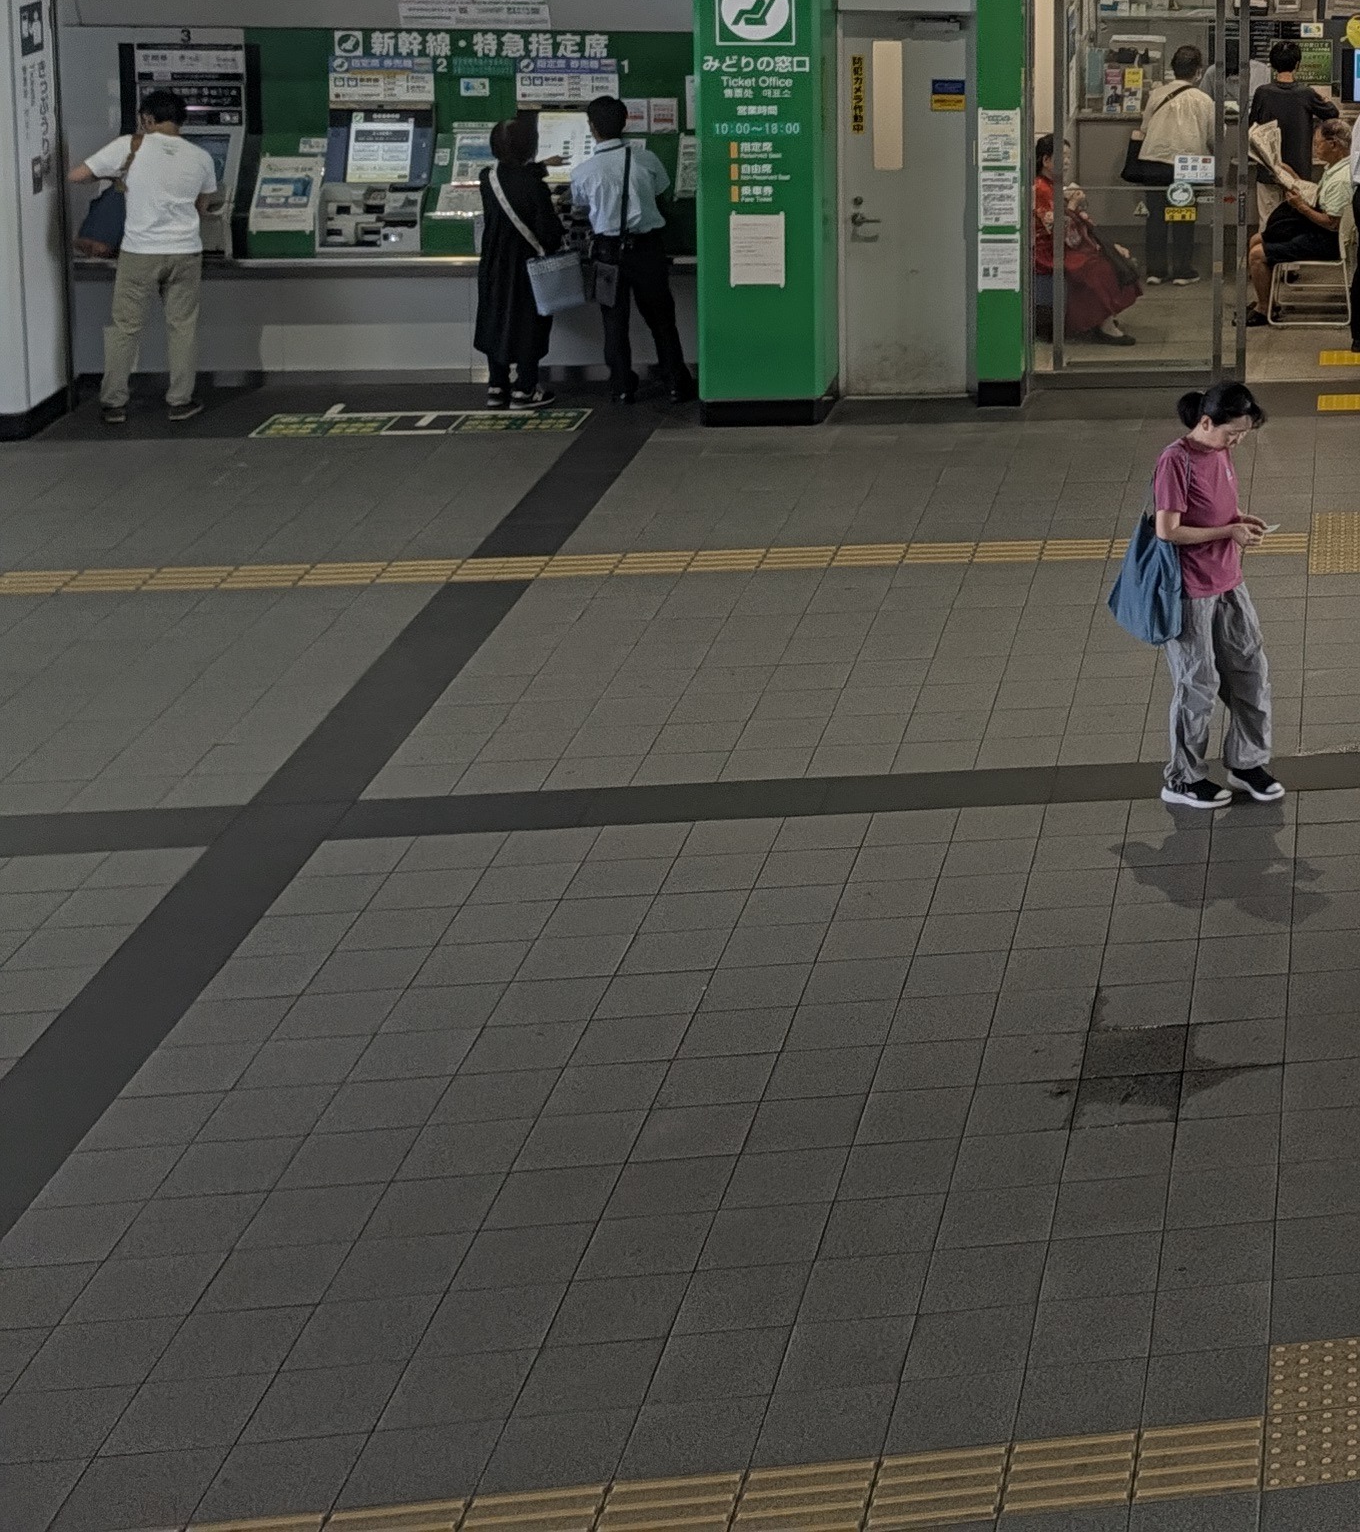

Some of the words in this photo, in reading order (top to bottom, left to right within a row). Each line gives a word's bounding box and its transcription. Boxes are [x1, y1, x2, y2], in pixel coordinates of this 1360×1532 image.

[181, 28, 191, 43] 3
[371, 31, 609, 58] 新幹線・特急指定席
[436, 58, 448, 72] 2
[621, 60, 629, 73] 1
[703, 55, 810, 73] みどりの窓口
[721, 76, 756, 87] Ticket
[758, 76, 793, 88] Office
